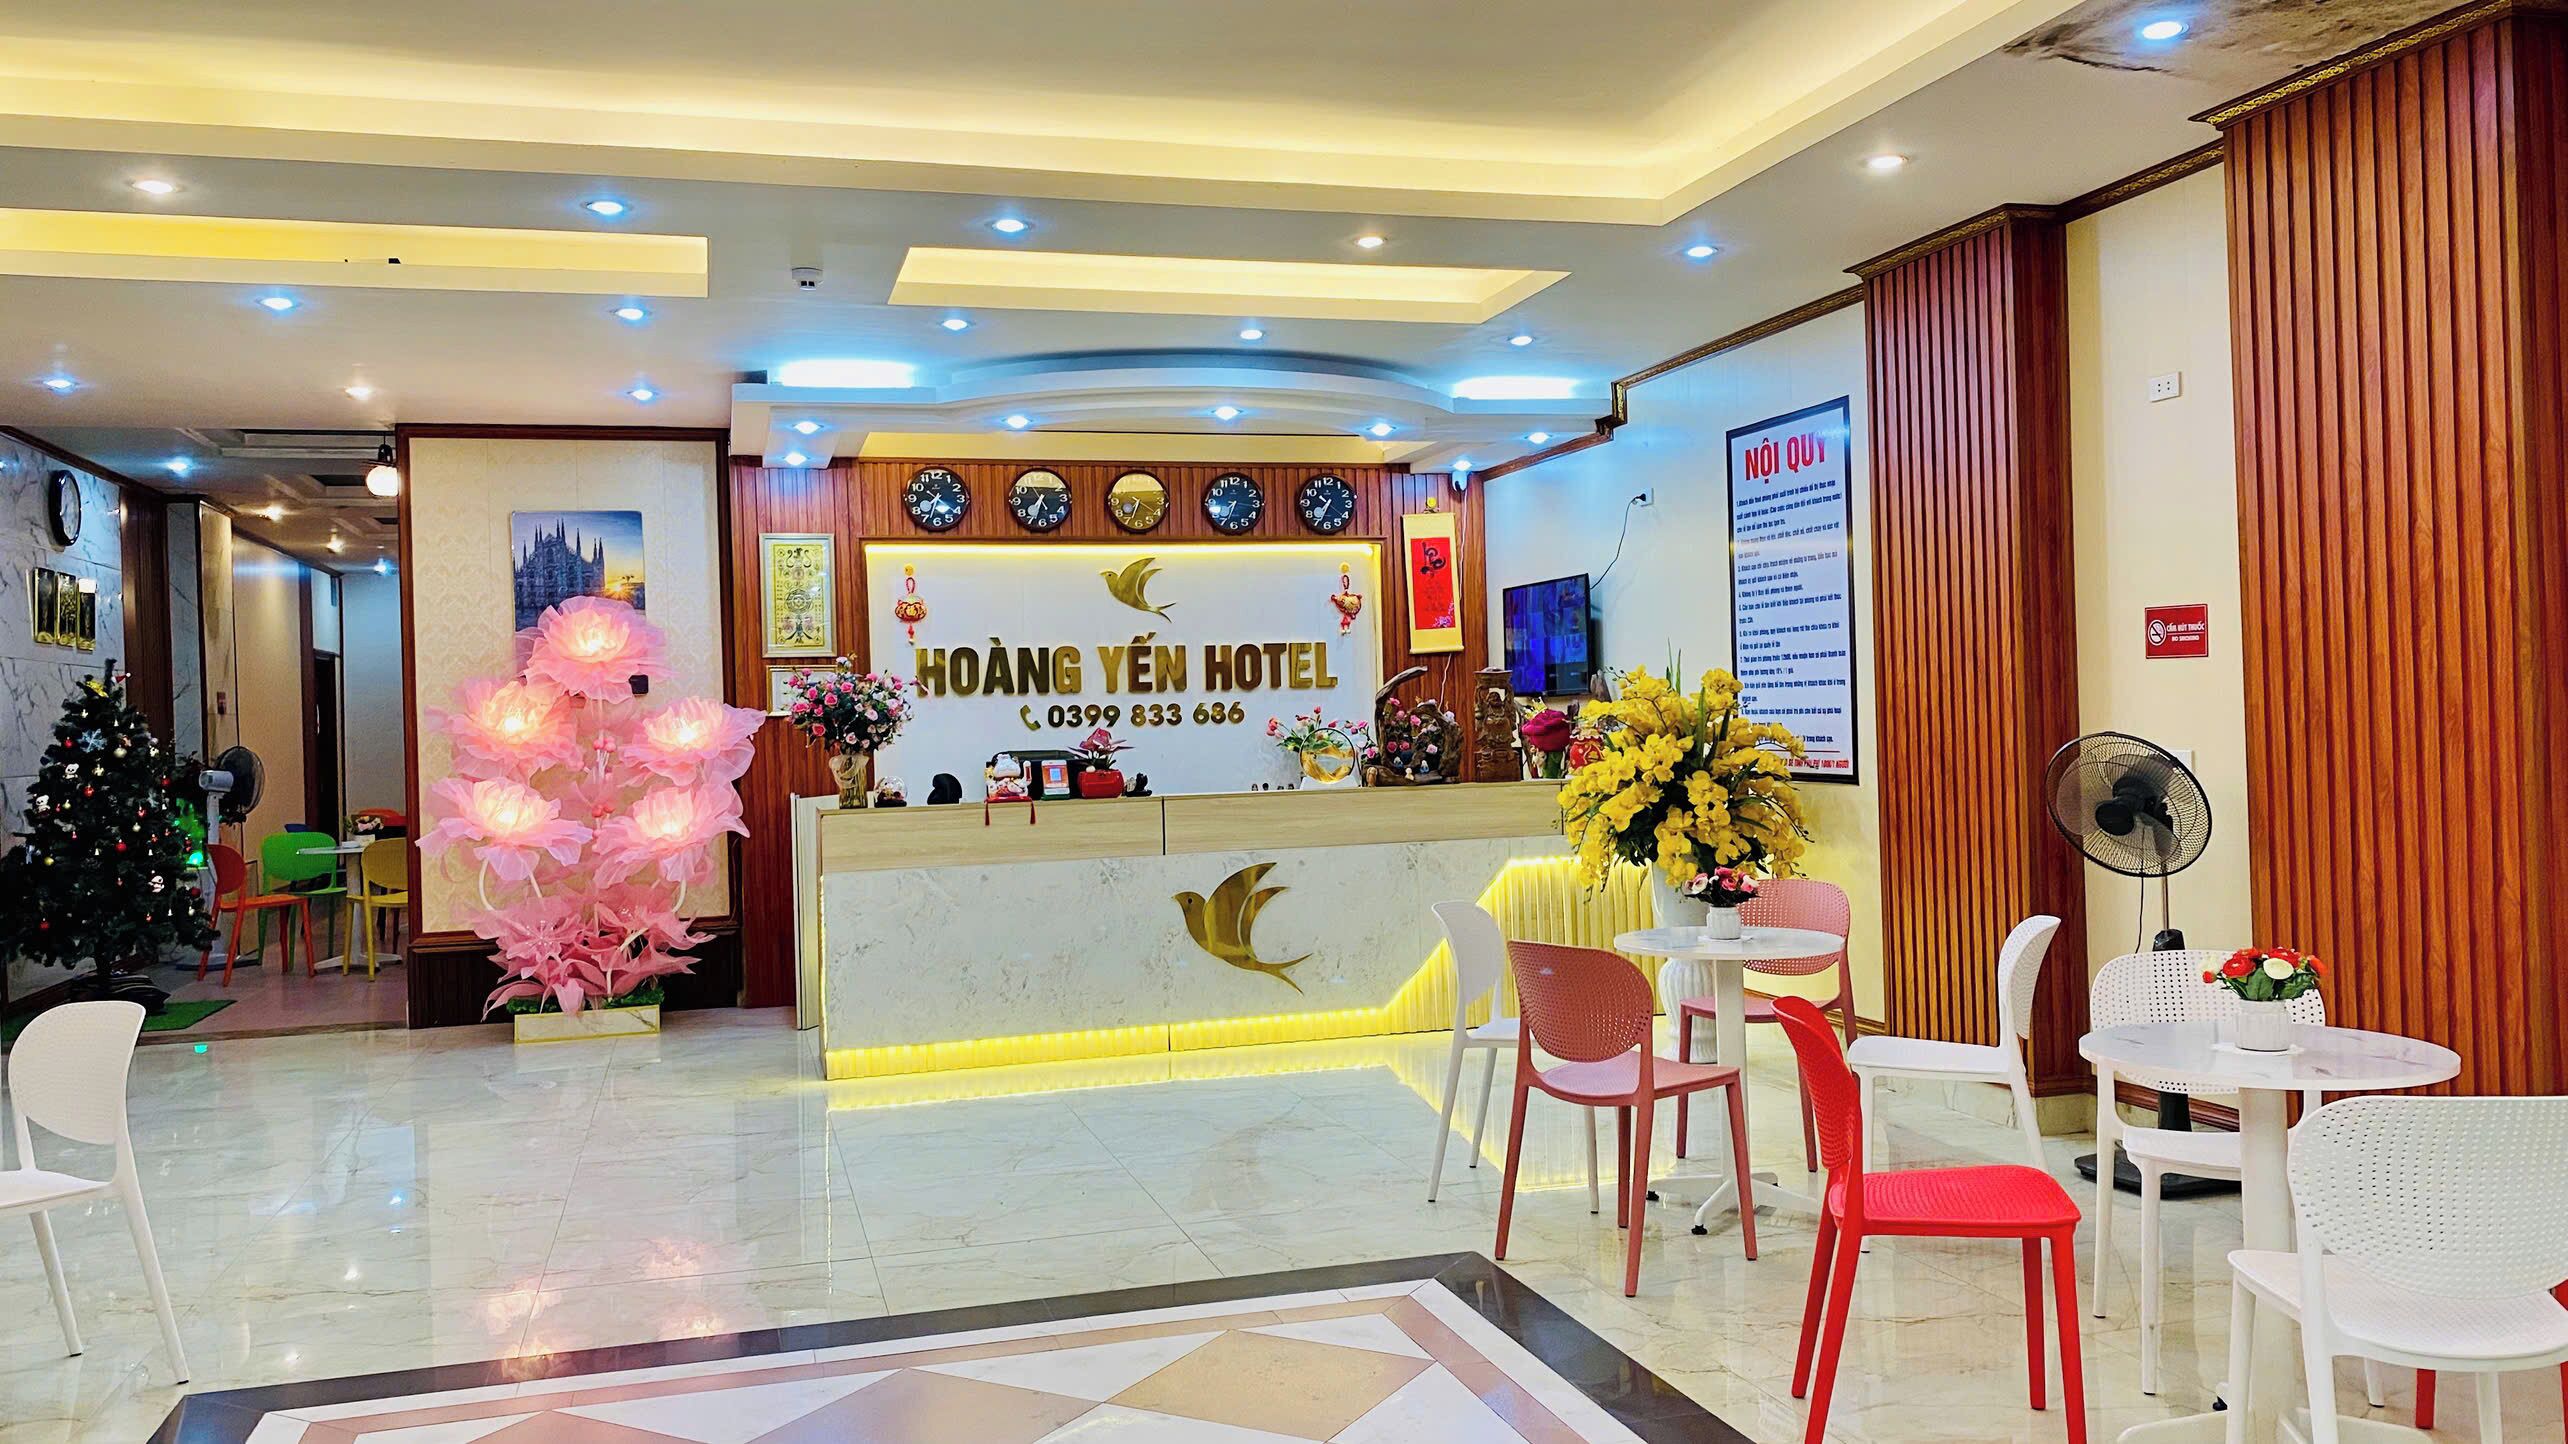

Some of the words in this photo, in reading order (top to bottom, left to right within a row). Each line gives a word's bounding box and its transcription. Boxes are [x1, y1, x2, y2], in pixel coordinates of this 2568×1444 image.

[1745, 437, 1779, 484] NỘI
[946, 475, 951, 483] 1
[1229, 477, 1240, 485] 12
[912, 483, 924, 491] 10
[1220, 480, 1227, 488] 11
[1314, 480, 1321, 488] 11
[1212, 488, 1223, 496] 10
[1249, 489, 1256, 497] 2
[908, 494, 917, 502] 9
[1012, 497, 1021, 505] 9
[1059, 494, 1067, 502] 3
[1157, 497, 1164, 505] 3
[1345, 500, 1352, 508] 3
[953, 506, 961, 514] 4
[1018, 509, 1026, 517] 8
[1049, 514, 1057, 522] 5
[1249, 511, 1256, 519] 4
[1342, 511, 1349, 519] 4
[933, 518, 941, 526] 6
[1146, 516, 1153, 524] 5
[1241, 518, 1248, 526] 5
[1334, 518, 1341, 526] 5
[916, 637, 1082, 698] HOÀNG
[1097, 632, 1188, 694] YẾN
[1205, 642, 1338, 691] HOTEL
[1048, 704, 1121, 728] 0399
[1131, 703, 1183, 727] 833
[1193, 702, 1245, 725] 686
